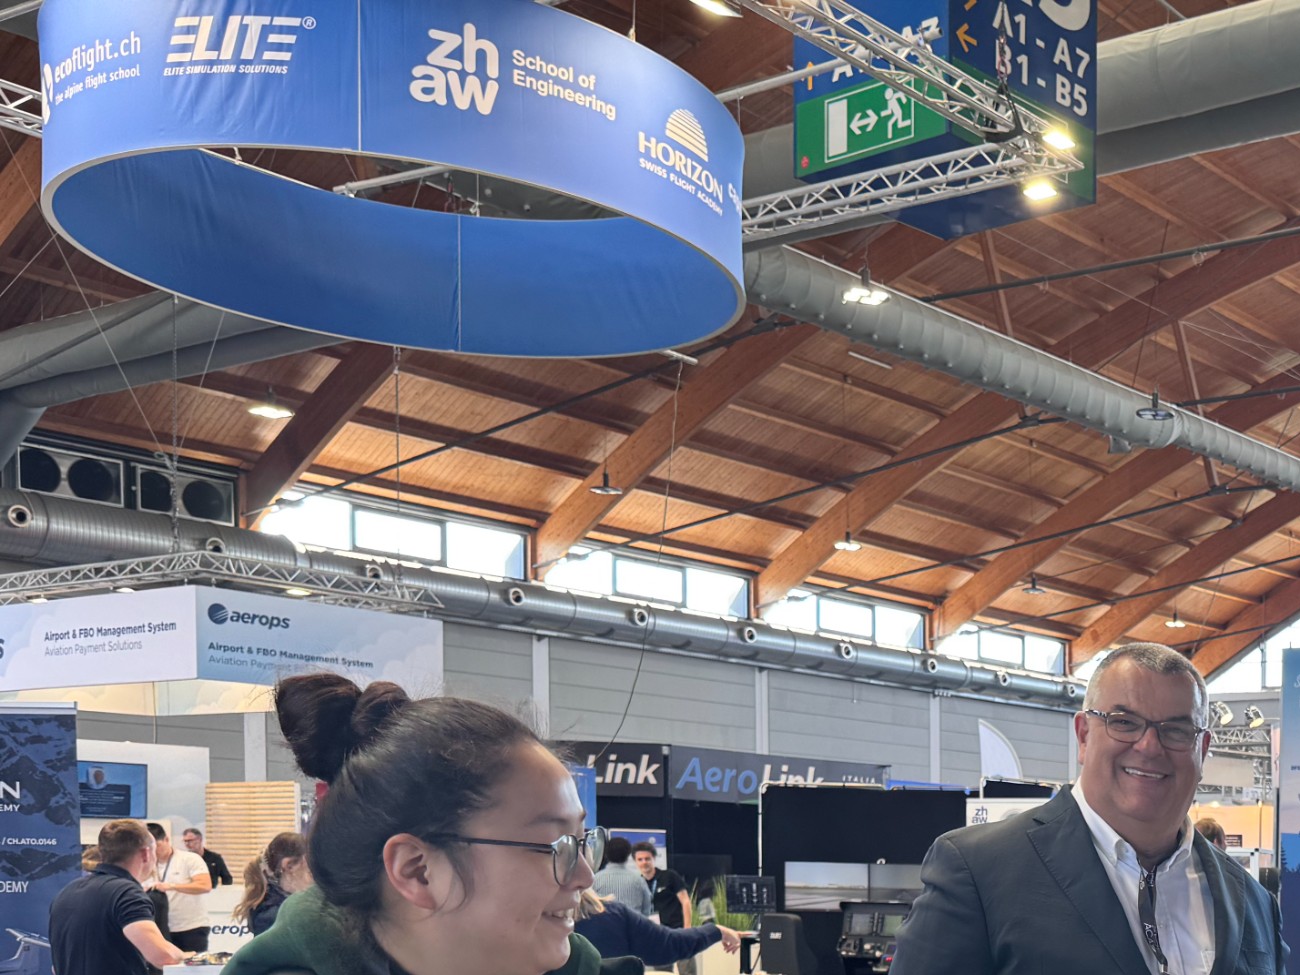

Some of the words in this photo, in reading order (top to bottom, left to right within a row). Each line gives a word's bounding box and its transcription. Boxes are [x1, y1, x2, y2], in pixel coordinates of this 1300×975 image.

[54, 31, 141, 84] ecoflight.ch
[163, 66, 185, 77] ELITE
[186, 64, 236, 75] SIMULATION
[239, 64, 288, 75] SOLUTIONS
[512, 50, 573, 83] School
[578, 72, 596, 90] of
[1053, 37, 1091, 79] A7
[64, 82, 84, 101] alpine
[85, 72, 107, 91] flight
[109, 65, 141, 82] school
[512, 69, 617, 121] Engineering
[1055, 73, 1088, 117] B5
[637, 131, 724, 204] HORIZON
[639, 158, 667, 180] SWISS
[669, 171, 696, 195] FLIGHT
[44, 630, 70, 643] Airport
[71, 629, 77, 639] &
[78, 628, 95, 639] FBO
[96, 623, 146, 638] Management
[147, 621, 177, 635] System
[229, 610, 291, 630] aerops
[44, 645, 73, 657] Aviation
[74, 643, 106, 656] Payment
[108, 639, 142, 652] Solutions
[208, 642, 244, 655] Airport
[247, 647, 254, 655] &
[256, 647, 277, 657] FBO
[279, 650, 339, 665] Management
[341, 657, 374, 669] System
[208, 655, 248, 667] Aviation
